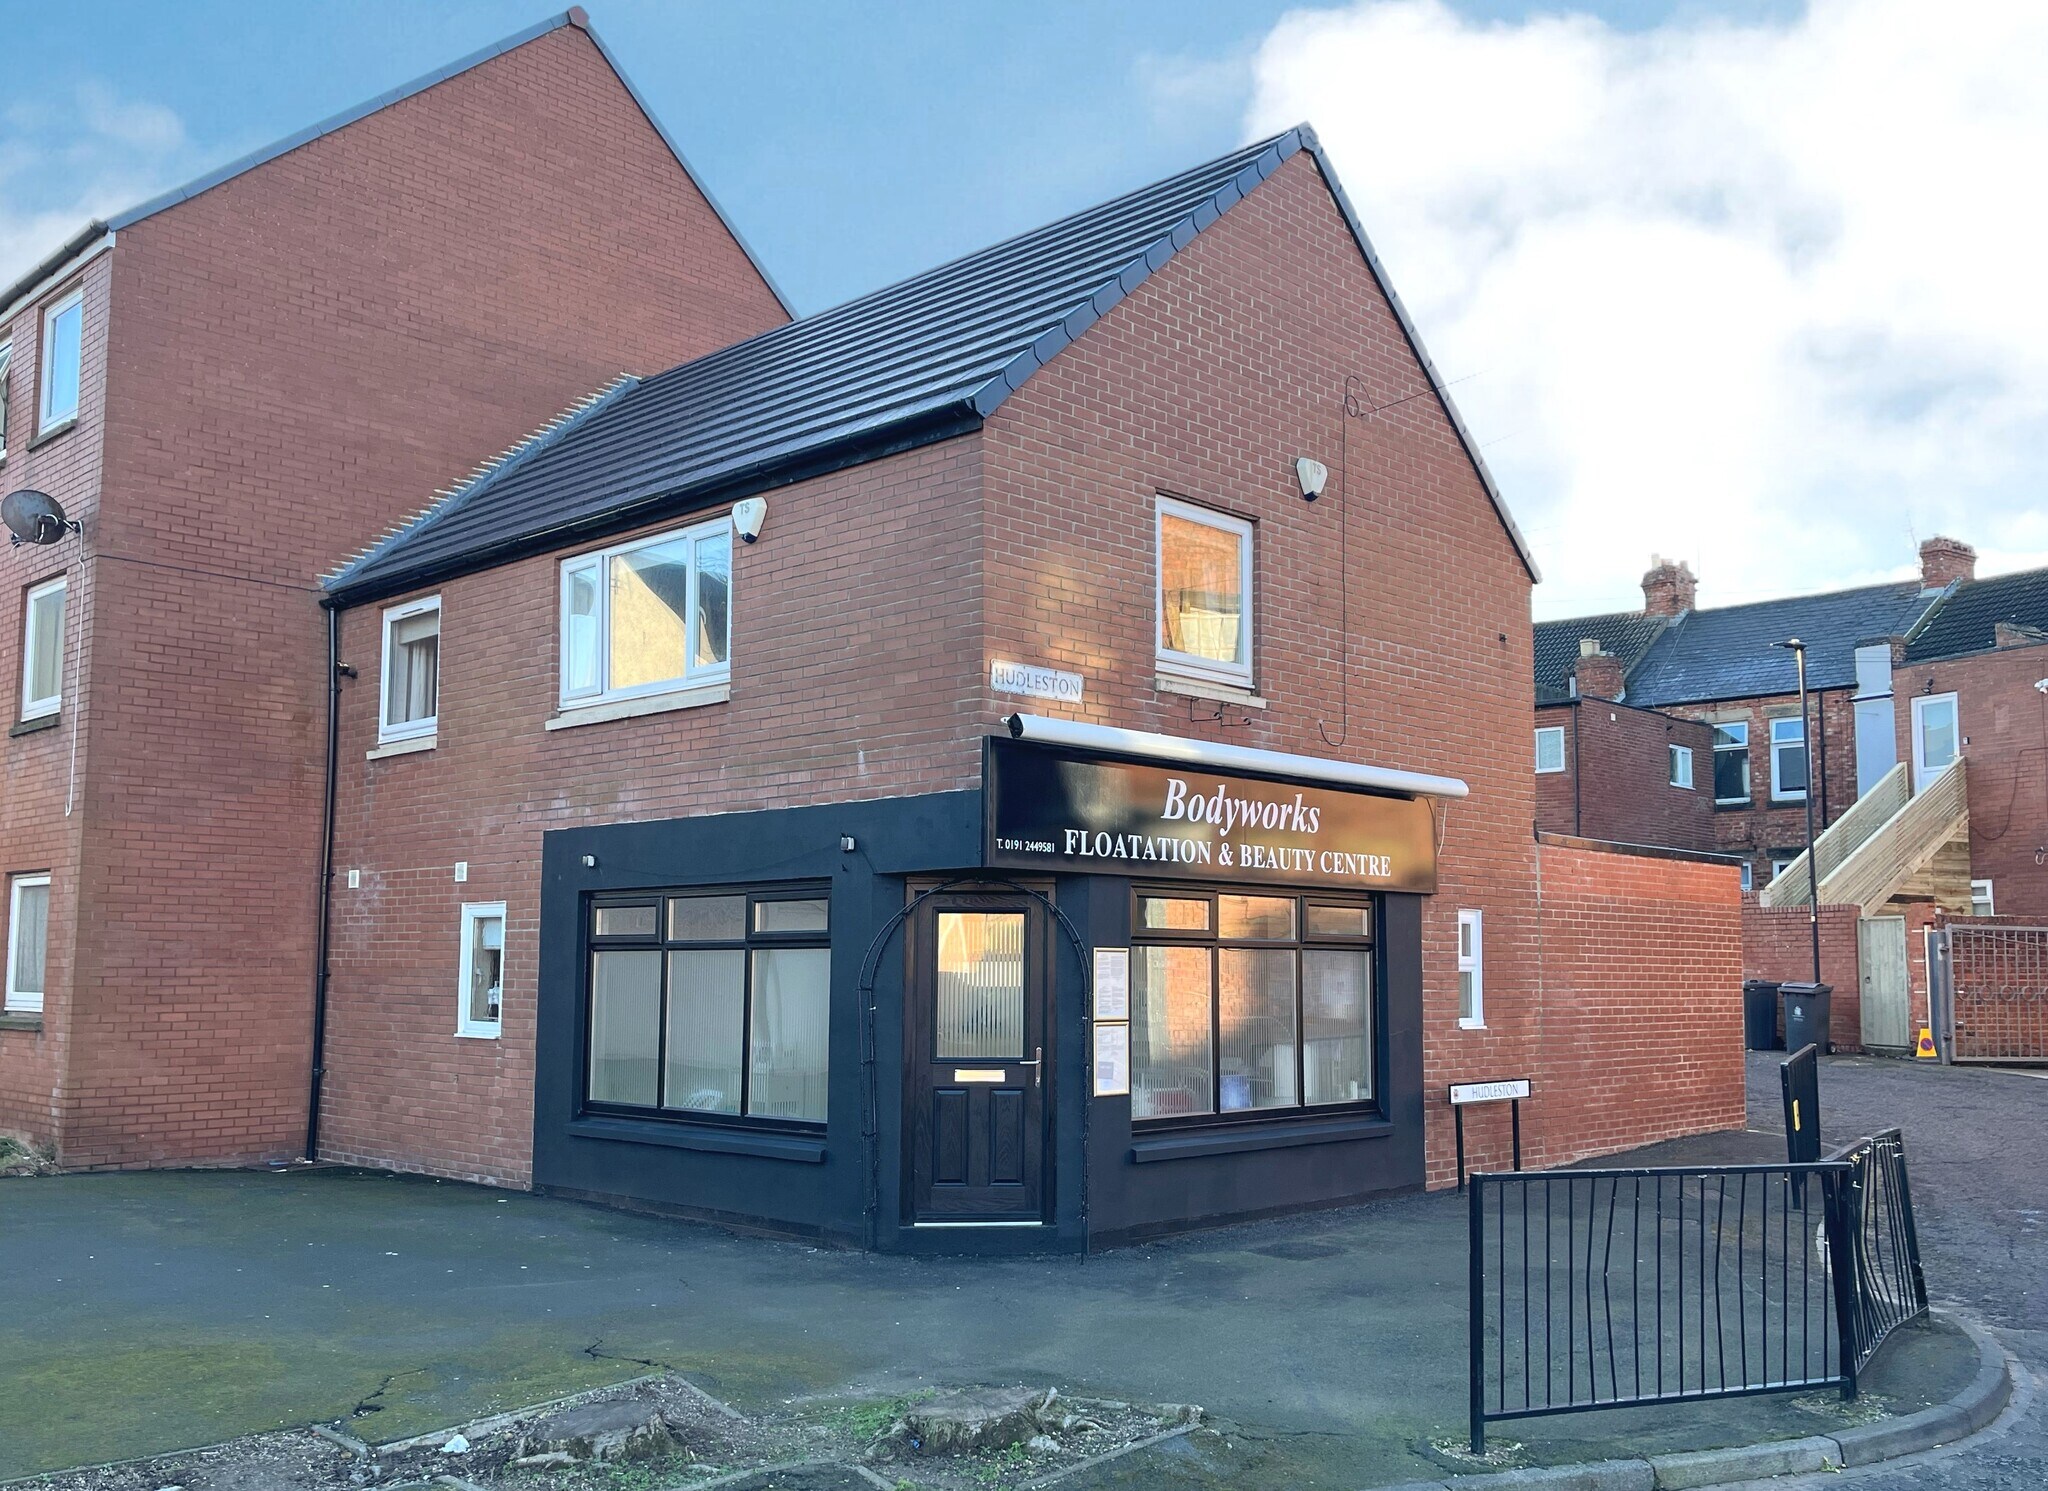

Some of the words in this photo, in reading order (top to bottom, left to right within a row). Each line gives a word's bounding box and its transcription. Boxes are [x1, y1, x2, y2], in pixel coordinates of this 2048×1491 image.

[739, 502, 750, 515] TS
[995, 667, 1080, 696] HUDLESTON
[1160, 778, 1321, 837] Bodyworks
[996, 838, 1004, 849] T.
[1005, 839, 1023, 851] 0191
[1025, 840, 1055, 853] 2449581
[1064, 828, 1212, 865] FLOATATION
[1218, 842, 1234, 867] &
[1239, 844, 1317, 872] BEAUTY
[1320, 851, 1392, 877] CENTRE
[1472, 1083, 1518, 1099] HUDLESTON
